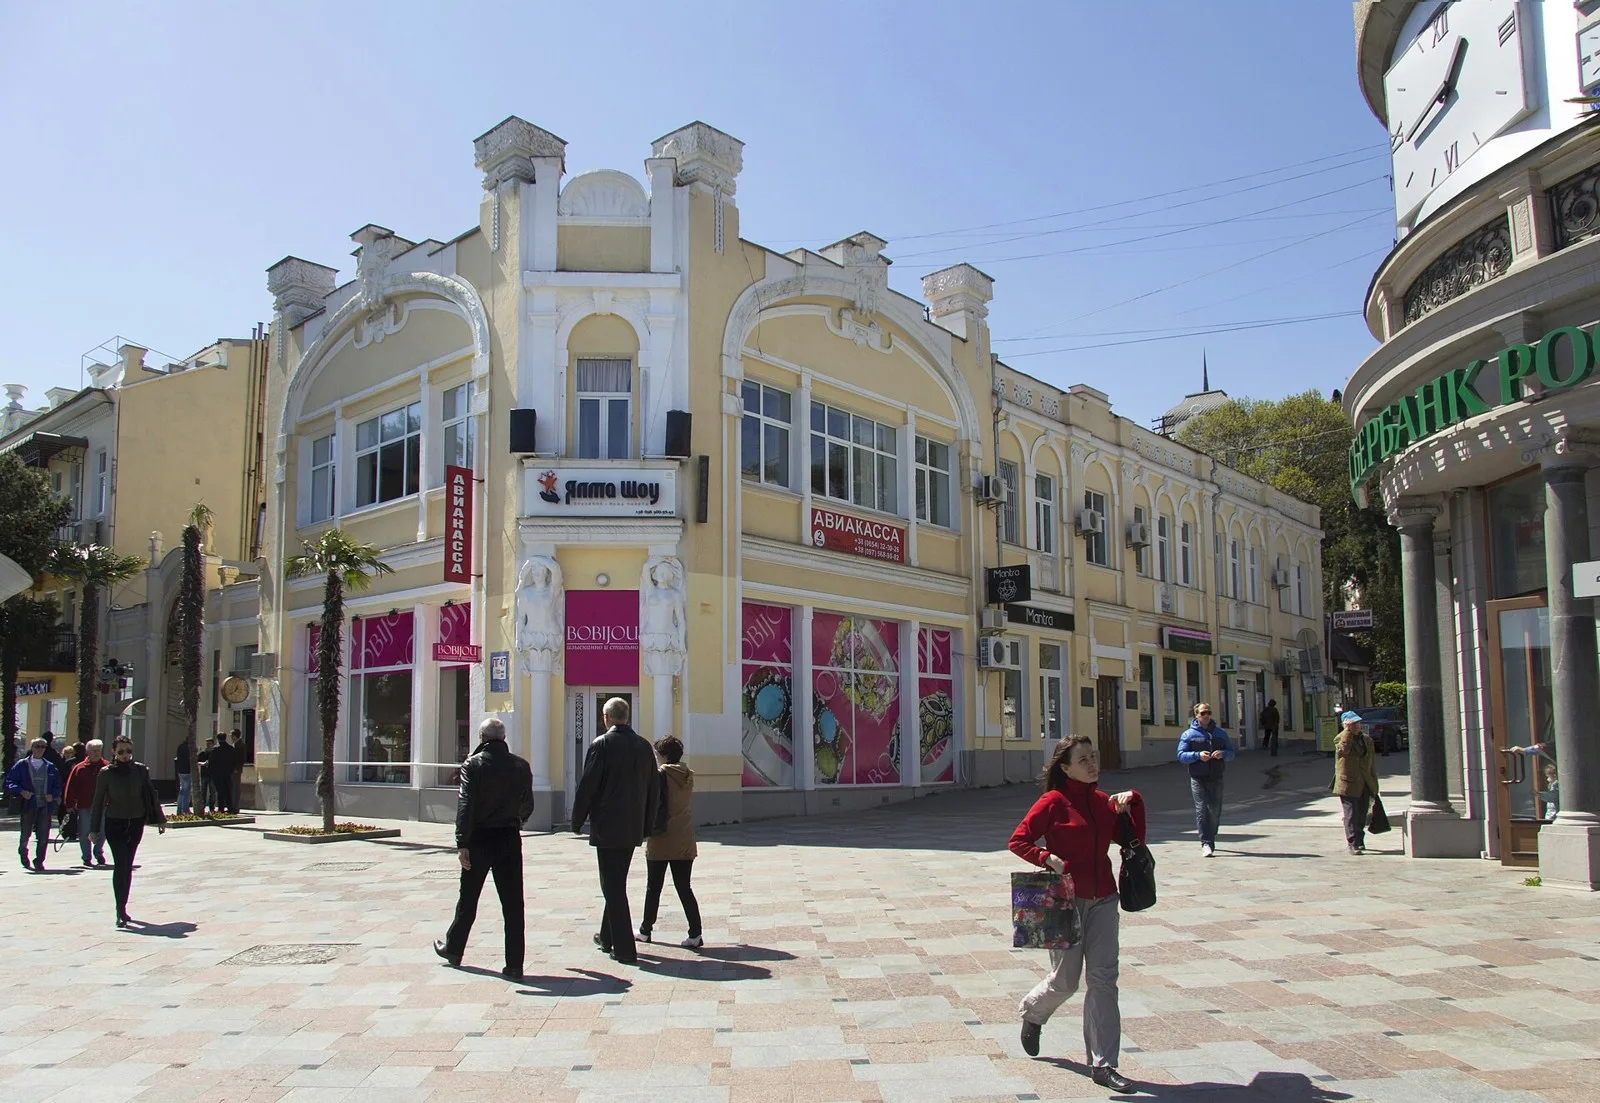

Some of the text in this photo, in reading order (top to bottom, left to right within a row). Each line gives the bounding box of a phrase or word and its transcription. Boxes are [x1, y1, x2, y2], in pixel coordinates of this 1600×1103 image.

[1432, 7, 1449, 48] XII
[1497, 10, 1516, 47] III
[1444, 140, 1459, 174] VI
[1496, 322, 1600, 405] РО
[565, 480, 660, 504] Ялта Шоу
[451, 474, 465, 574] АВИАКАССА
[813, 510, 900, 544] АВИАКАССА
[817, 530, 822, 539] 2
[993, 569, 1020, 579] Mantra
[1025, 607, 1054, 626] Mantra
[567, 625, 638, 645] BOBIJOU
[437, 644, 477, 657] BOBIJOU
